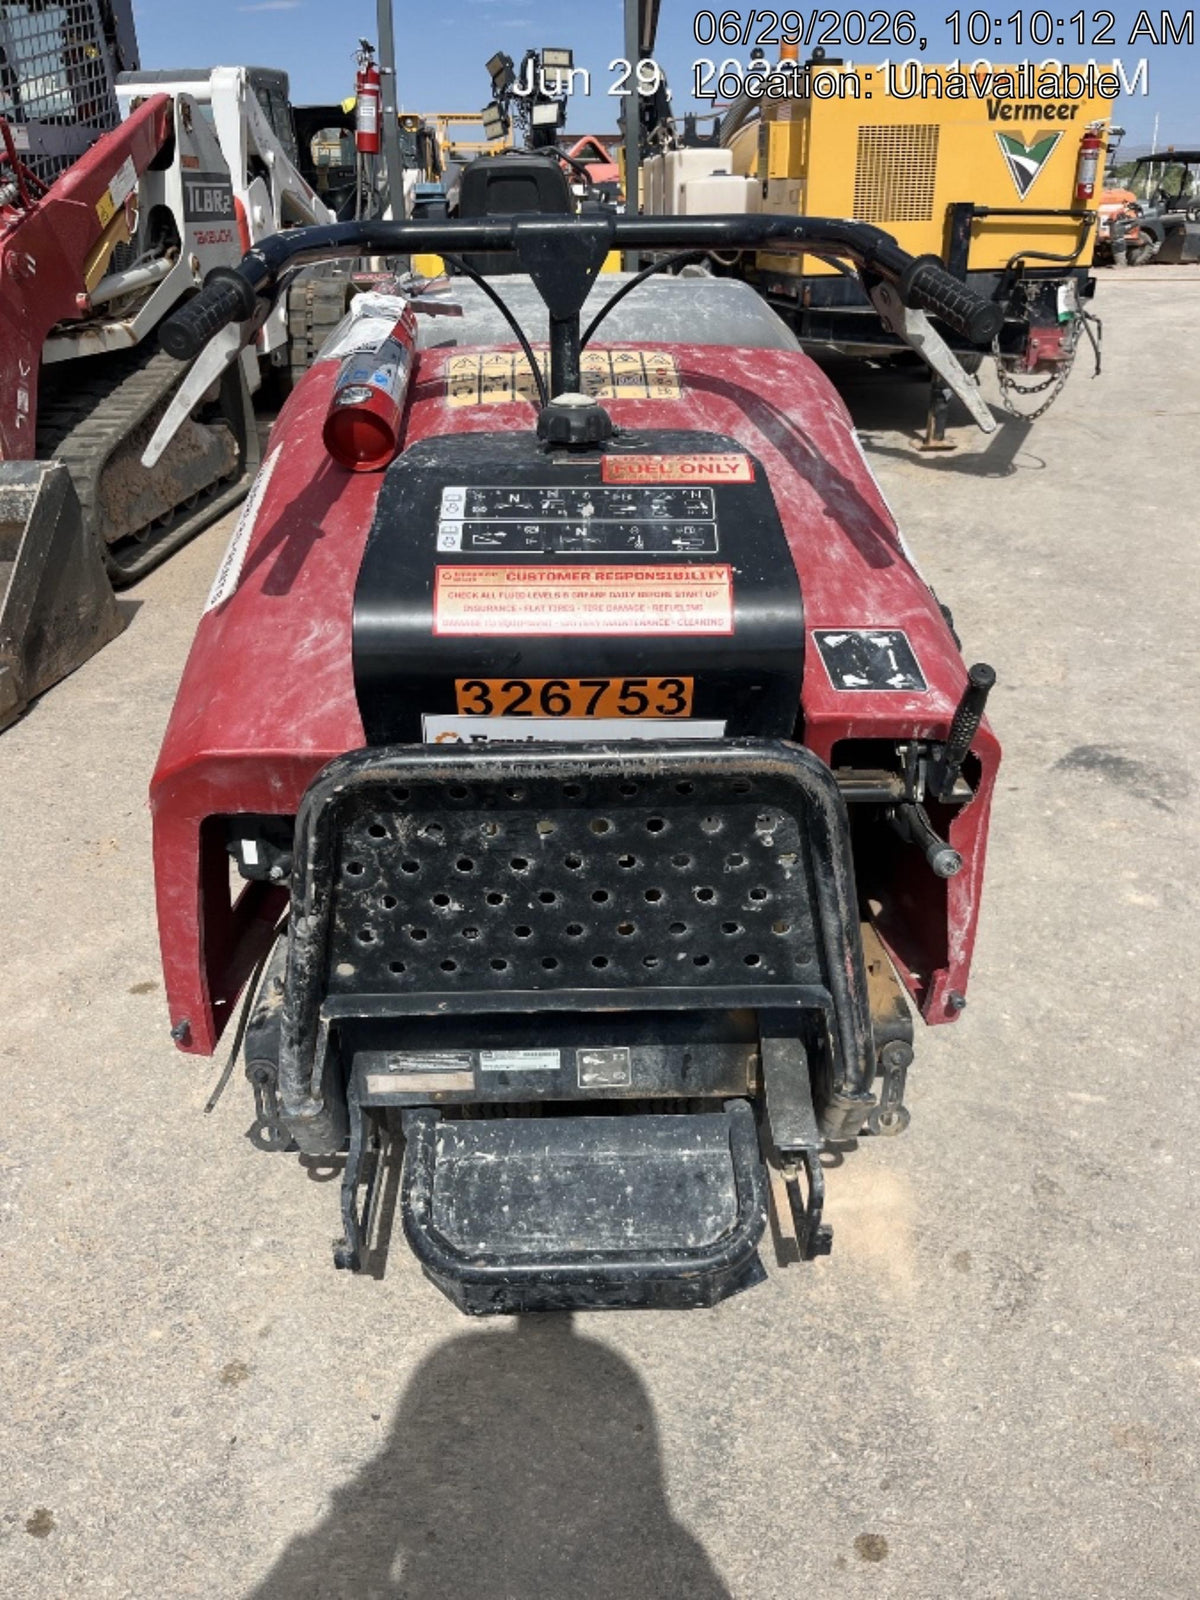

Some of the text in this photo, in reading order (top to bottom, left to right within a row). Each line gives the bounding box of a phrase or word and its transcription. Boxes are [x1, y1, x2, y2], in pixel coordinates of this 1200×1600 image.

[985, 99, 1080, 121] Vermeer
[614, 463, 741, 475] FUEL ONLY
[505, 571, 591, 582] CUSTOMER
[595, 571, 724, 581] RESPONSIBILITY
[461, 678, 688, 717] 326753
